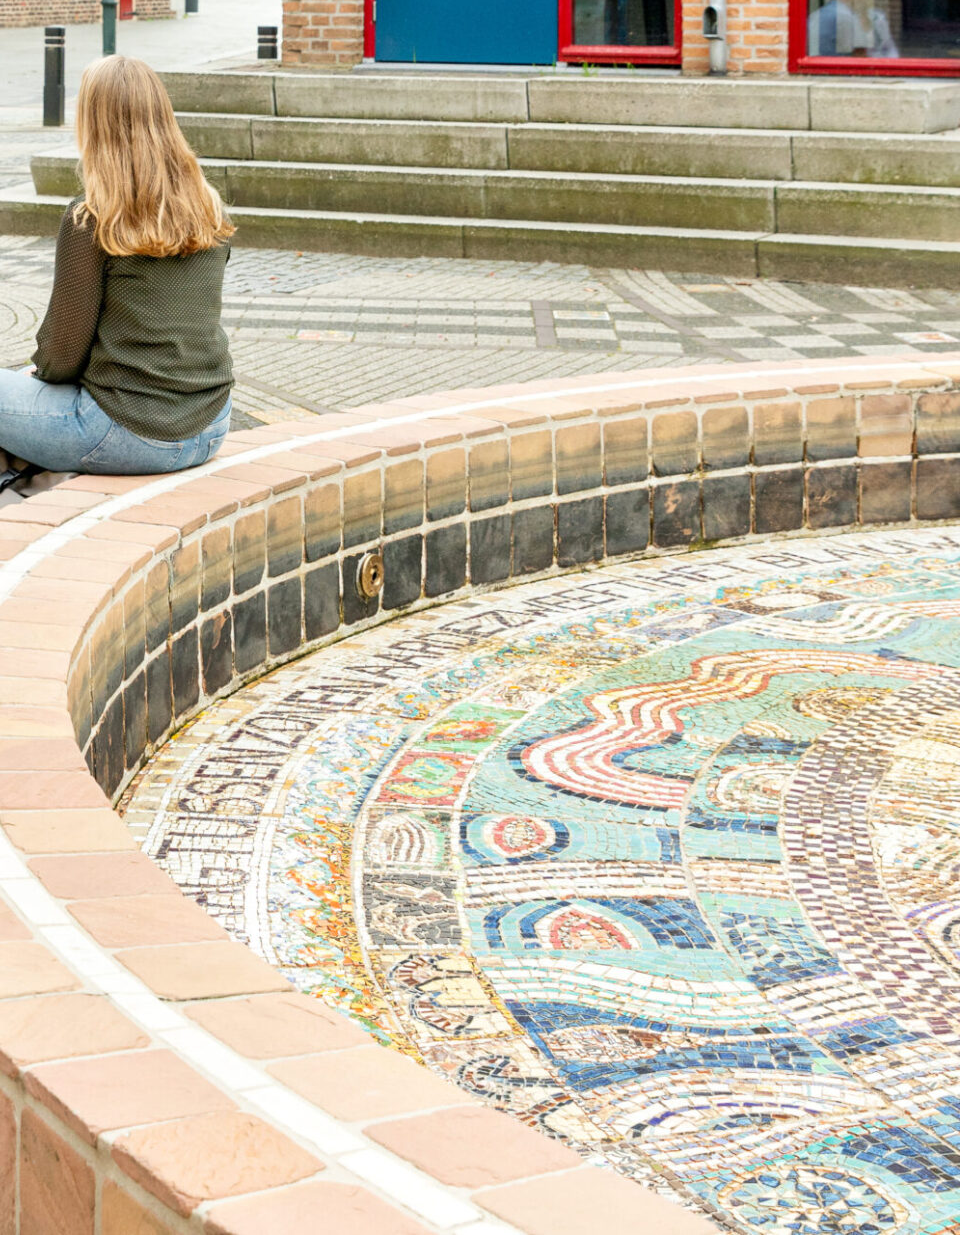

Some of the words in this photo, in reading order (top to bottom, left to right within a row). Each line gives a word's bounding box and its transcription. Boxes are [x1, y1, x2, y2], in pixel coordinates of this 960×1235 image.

[156, 746, 290, 856] TUSSEN
[228, 702, 338, 748] ZON
[283, 676, 388, 706] EN
[344, 620, 507, 679] AARDE
[463, 578, 656, 628] ZWEEFT
[634, 560, 757, 587] HET
[748, 535, 960, 569] BLAUW
